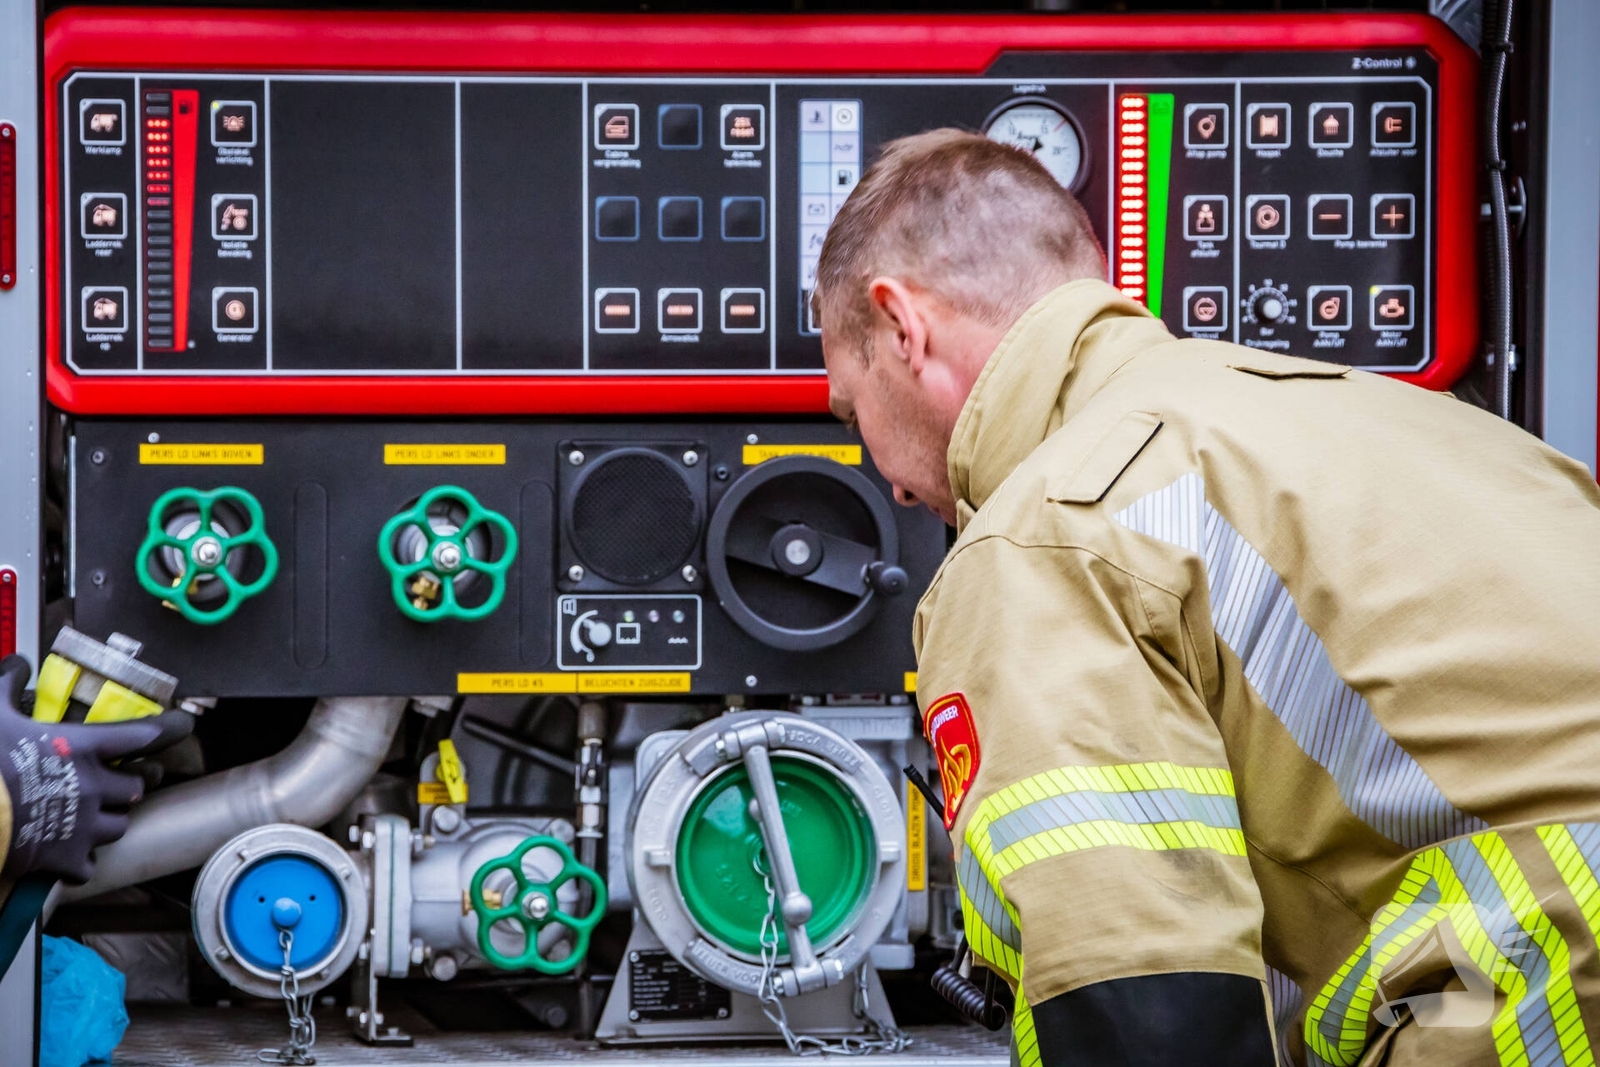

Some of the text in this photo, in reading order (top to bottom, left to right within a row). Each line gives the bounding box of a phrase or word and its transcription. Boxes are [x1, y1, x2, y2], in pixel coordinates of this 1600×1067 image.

[1351, 56, 1403, 69] Z-Control
[150, 449, 173, 459] PERS
[192, 449, 218, 459] LINKS
[222, 449, 252, 459] BOVEN
[394, 449, 418, 459] PERS
[436, 449, 460, 459] LINKS
